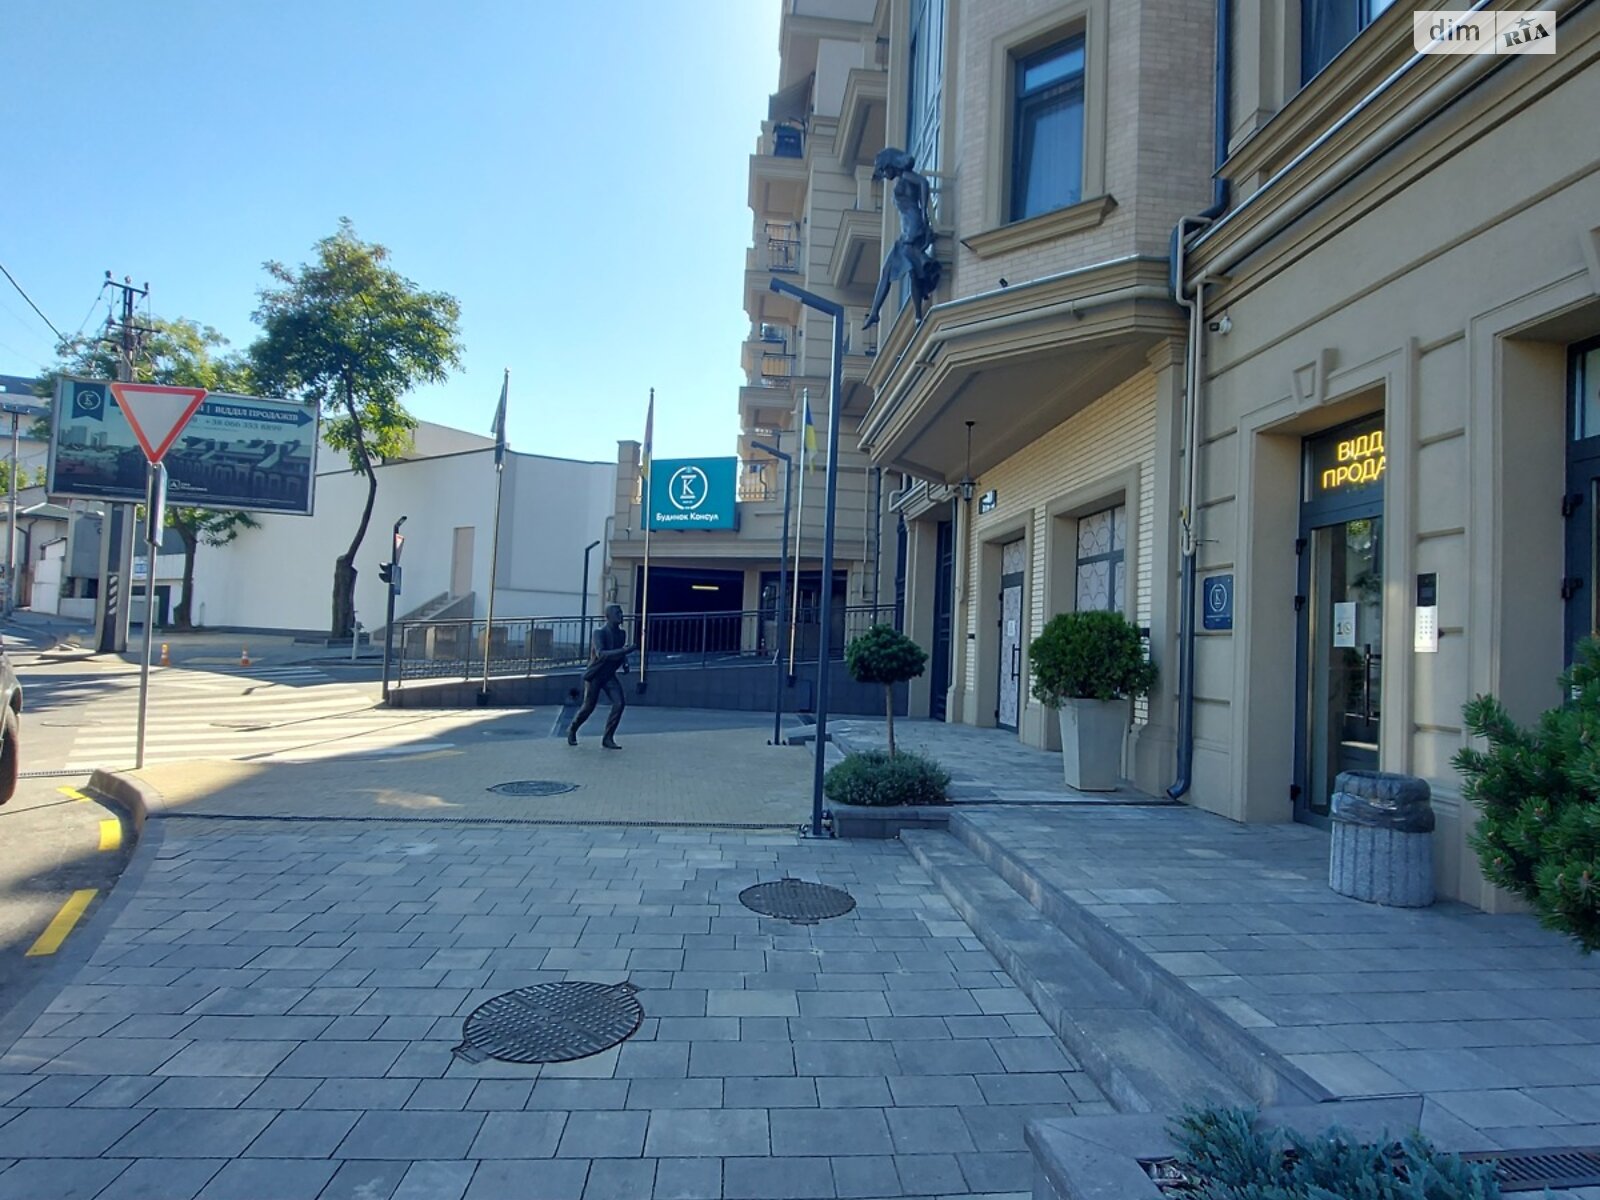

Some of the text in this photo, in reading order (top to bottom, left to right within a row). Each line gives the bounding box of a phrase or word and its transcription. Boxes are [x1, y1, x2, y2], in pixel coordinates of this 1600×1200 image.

[215, 406, 247, 417] ВІДДІЛ
[249, 409, 298, 421] ПРОДАЖІВ
[656, 511, 719, 522] Будинок Консул
